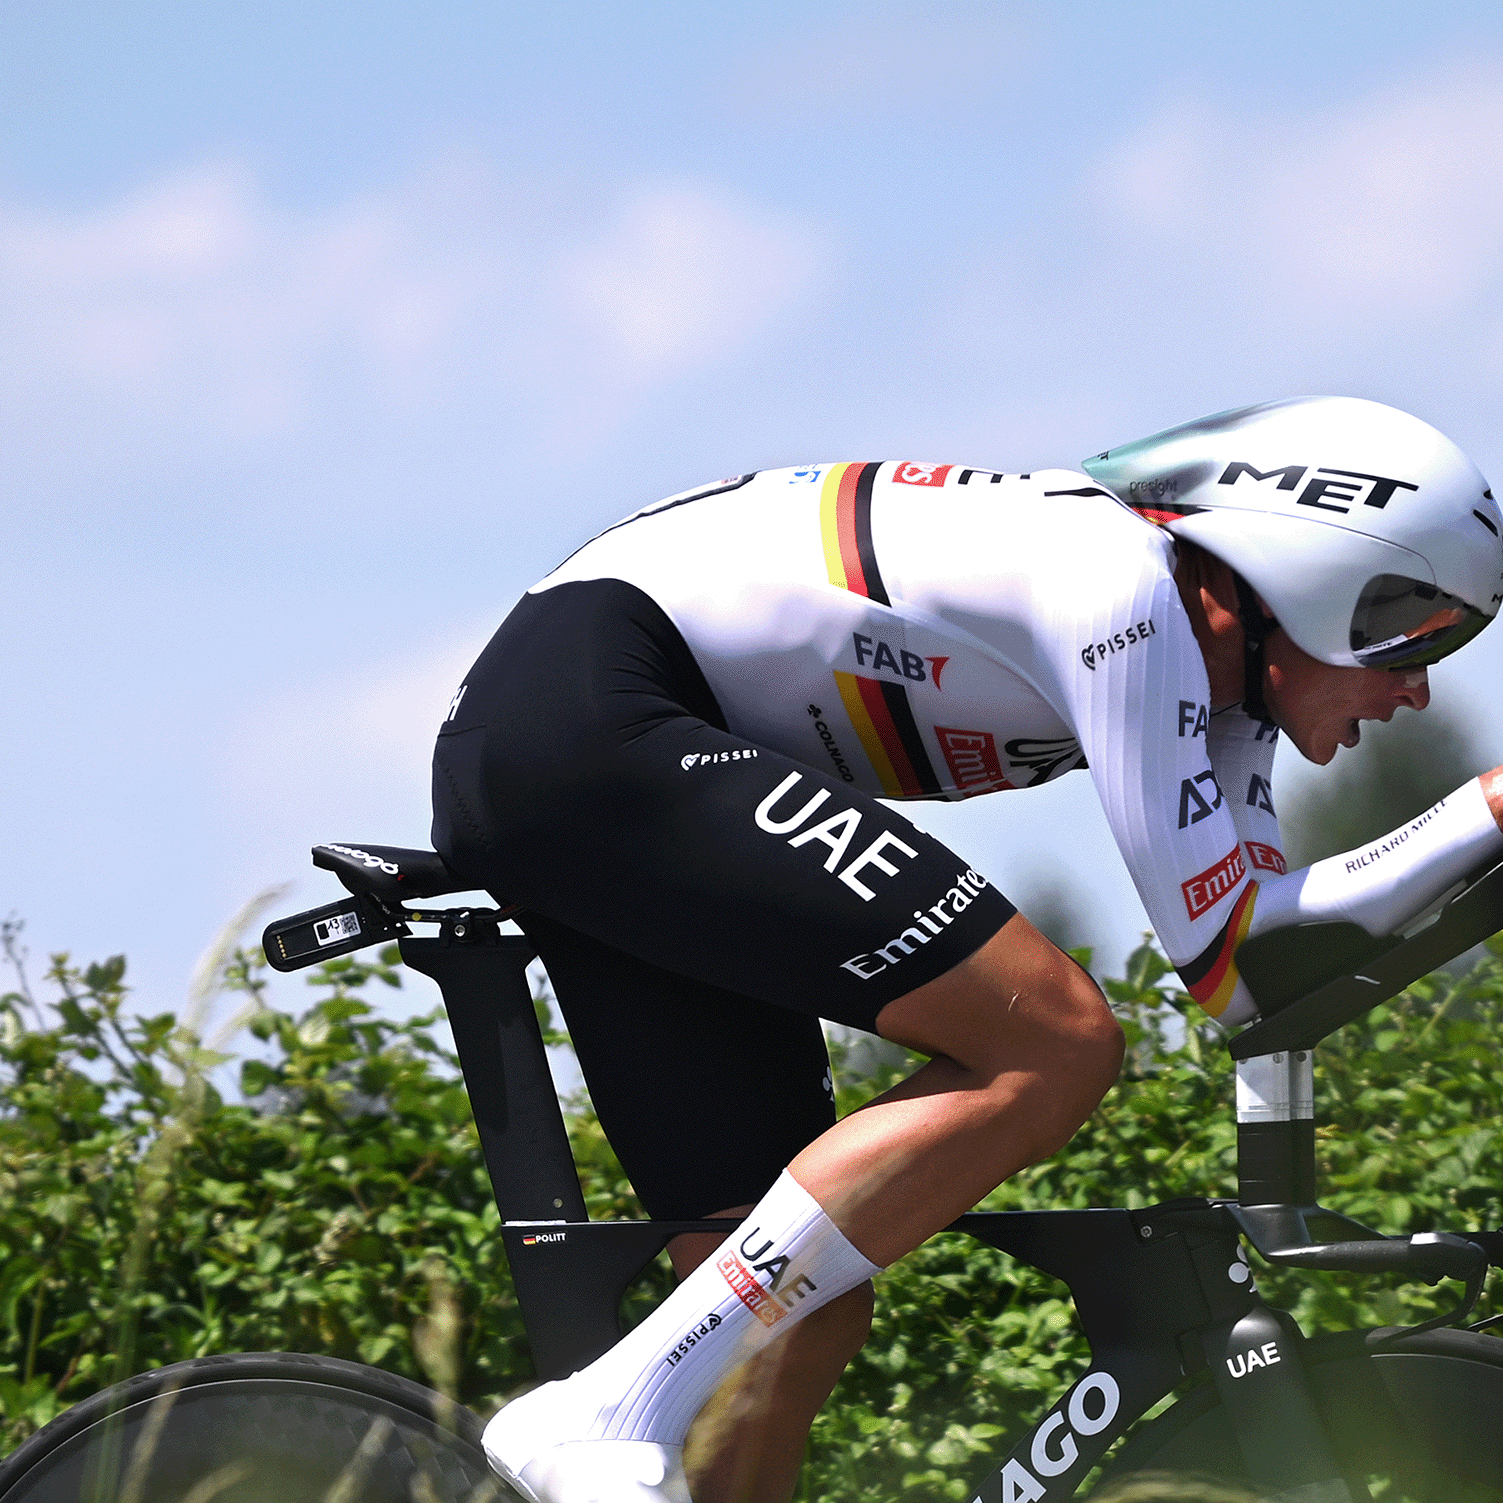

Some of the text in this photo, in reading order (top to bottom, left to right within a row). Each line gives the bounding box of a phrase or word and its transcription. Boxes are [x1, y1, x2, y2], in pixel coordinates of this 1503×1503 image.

[1129, 478, 1179, 497] presight
[1217, 461, 1420, 515] MET
[1096, 618, 1156, 660] PISSEI
[700, 748, 758, 766] PISSEI
[814, 721, 854, 783] COLNAGO
[754, 770, 920, 902] UAE
[535, 1232, 566, 1244] POLITT
[740, 1227, 818, 1309] UAE
[666, 1323, 710, 1367] PISSEI
[1226, 1341, 1282, 1378] UAE
